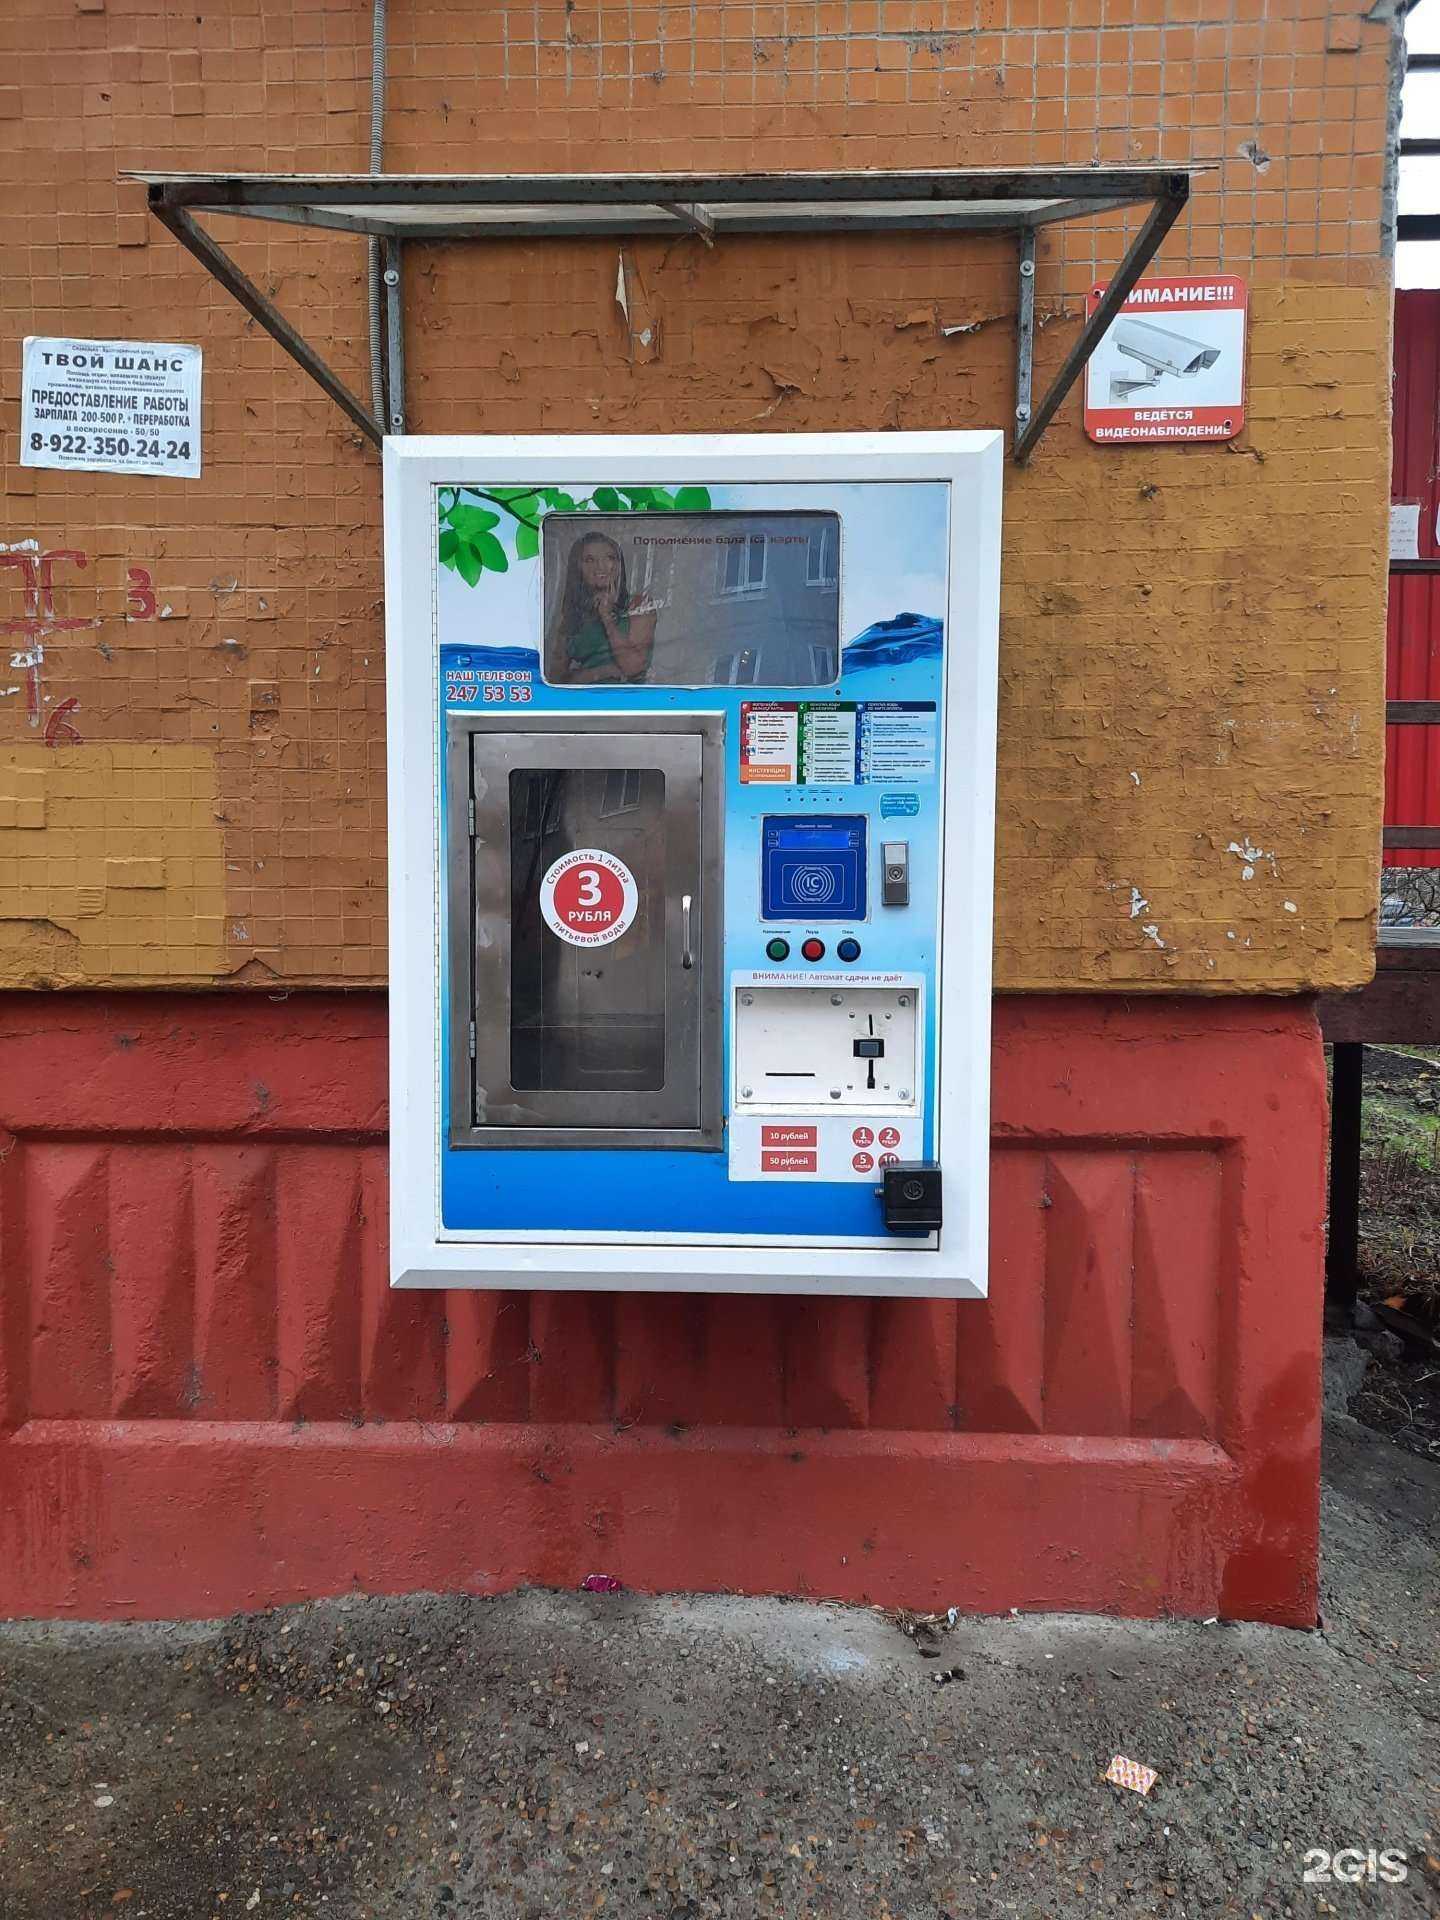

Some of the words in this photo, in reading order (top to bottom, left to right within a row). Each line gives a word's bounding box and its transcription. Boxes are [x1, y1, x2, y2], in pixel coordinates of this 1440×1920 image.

[1100, 286, 1235, 304] ИМАНИЕ!!!
[41, 352, 104, 369] ТВОЙ
[114, 357, 184, 372] ШАНС
[31, 389, 138, 410] ПРЕДОСТАВЛЕНИЕ
[143, 396, 189, 412] РАБОТЫ
[34, 407, 78, 421] ЗАРПЛАТА
[81, 410, 117, 424] 200-500
[133, 412, 191, 428] ПЕРЕРАБОТКА
[135, 427, 160, 437] 50/50
[1096, 425, 1232, 439] ВИДЕОНАБЛЮДЕНИЕ
[30, 432, 191, 460] 8-922-350-24-24
[633, 535, 712, 545] Пополнение
[446, 671, 474, 682] НАШ
[476, 671, 532, 682] ТЕЛЕФОН
[446, 685, 478, 702] 247
[484, 685, 506, 702] 53
[510, 685, 532, 702] 53
[546, 853, 595, 885] Стоимость
[597, 854, 604, 862] 1
[605, 858, 630, 884] литра
[577, 869, 602, 907] 3
[806, 876, 820, 888] IC
[568, 910, 612, 922] РУБЛЯ
[553, 922, 600, 944] питьевой
[601, 920, 626, 941] воды
[752, 972, 808, 981] ВНИМАНИЕ!
[808, 972, 843, 982] Автомат
[844, 974, 870, 983] сдачи
[781, 1132, 809, 1142] рублей
[860, 1128, 867, 1139] 1
[885, 1129, 894, 1140] 2
[769, 1157, 779, 1165] 50
[781, 1157, 809, 1167] рублей
[859, 1154, 867, 1165] 5
